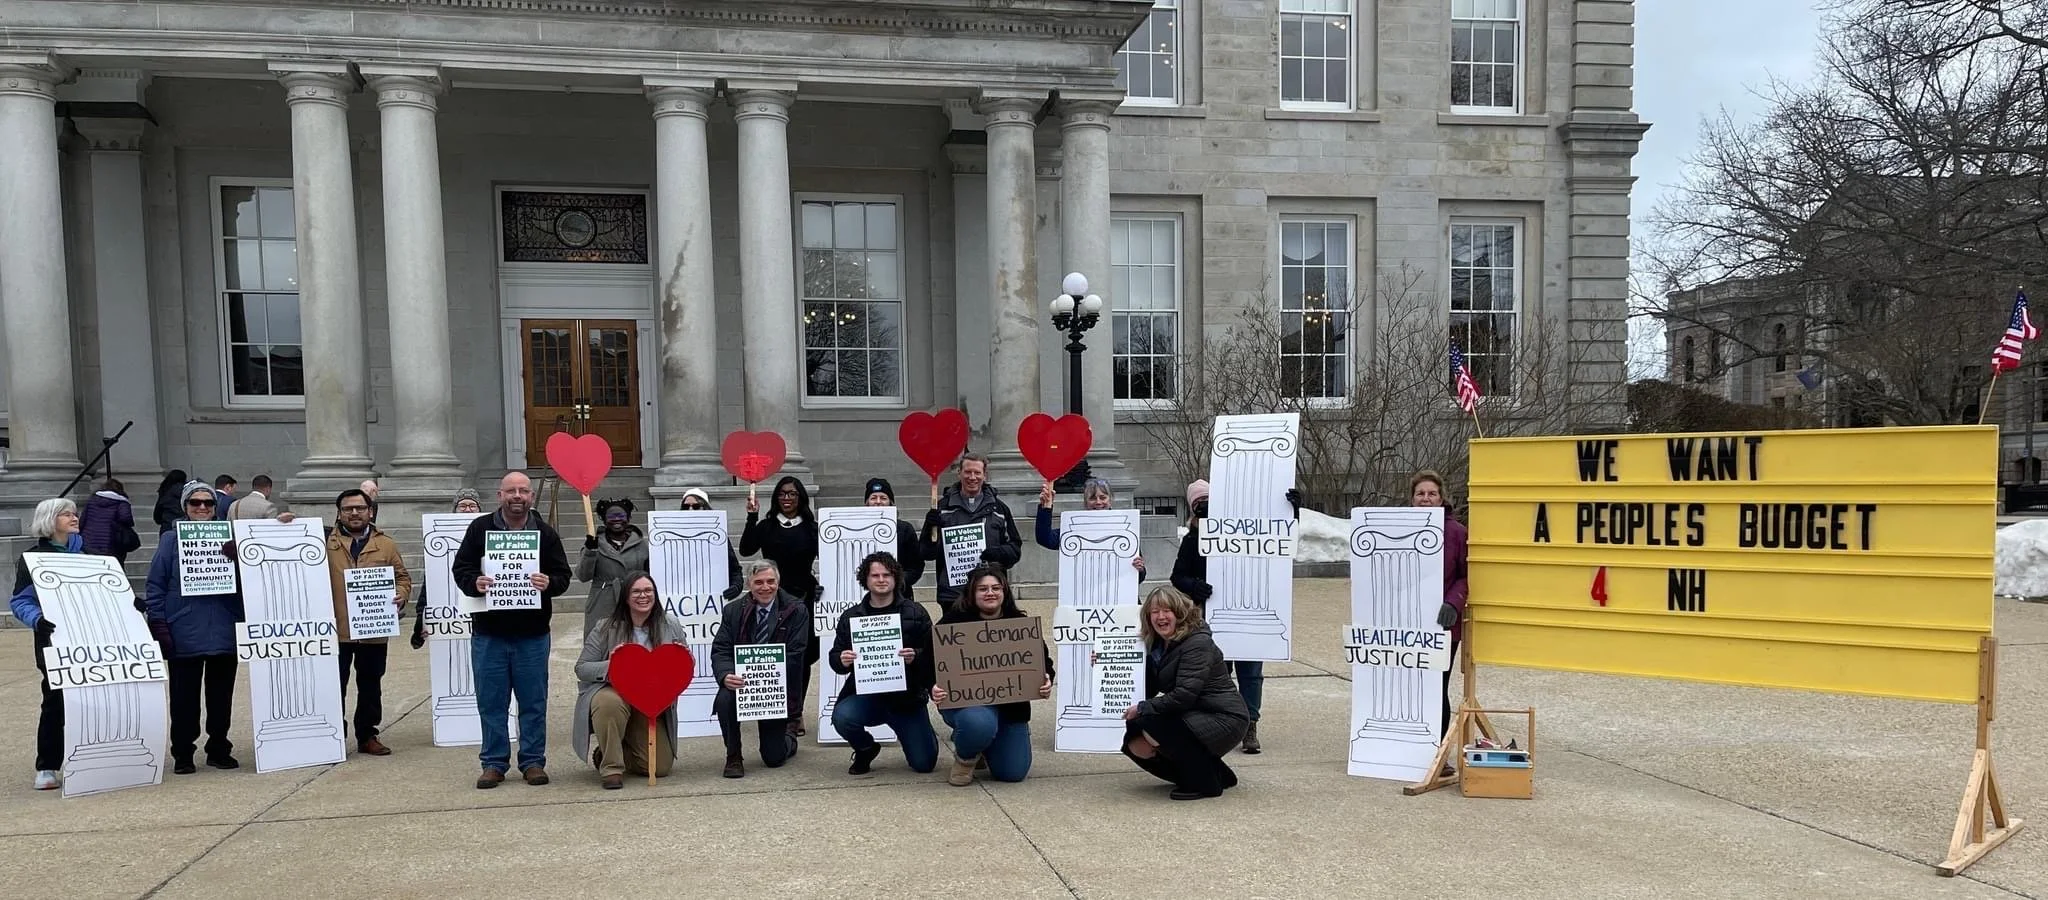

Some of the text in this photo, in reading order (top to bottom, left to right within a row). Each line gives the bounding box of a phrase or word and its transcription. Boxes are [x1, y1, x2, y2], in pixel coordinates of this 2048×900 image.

[1577, 436, 1762, 481] WE WANT
[1207, 519, 1295, 536] DISABILITY
[1534, 503, 1876, 550] A PEOPLES BUDGET
[1201, 537, 1292, 556] JUSTICE
[1591, 566, 1706, 612] 4 NH
[1076, 609, 1115, 624] TAX
[248, 622, 338, 639] EDUCATION
[935, 618, 1039, 646] We demand
[1352, 628, 1445, 650] HEALTHCARE
[57, 643, 155, 666] HOUSING
[238, 639, 331, 659] JUSTICE
[938, 648, 1032, 672] a humane
[1344, 646, 1429, 669] JUSTICE
[48, 660, 164, 686] JUSTICE
[739, 686, 784, 694] BACKBONE
[947, 674, 1022, 704] budget!
[739, 701, 785, 709] COMMUNITY
